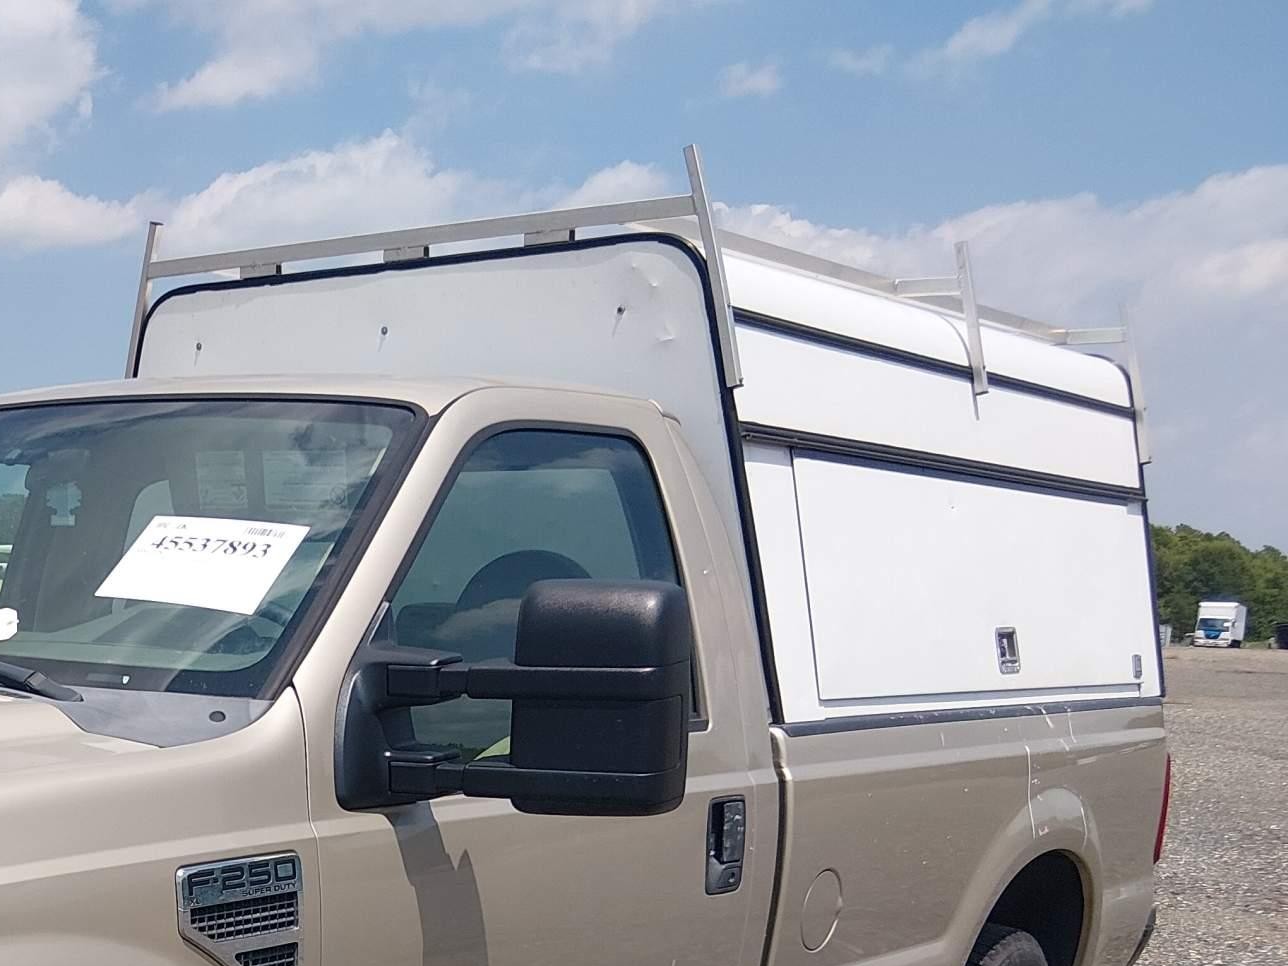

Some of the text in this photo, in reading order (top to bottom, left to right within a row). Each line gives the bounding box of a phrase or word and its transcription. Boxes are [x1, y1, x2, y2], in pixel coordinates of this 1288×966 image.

[152, 535, 272, 558] 45537893
[242, 882, 297, 897] SUPER DUTY
